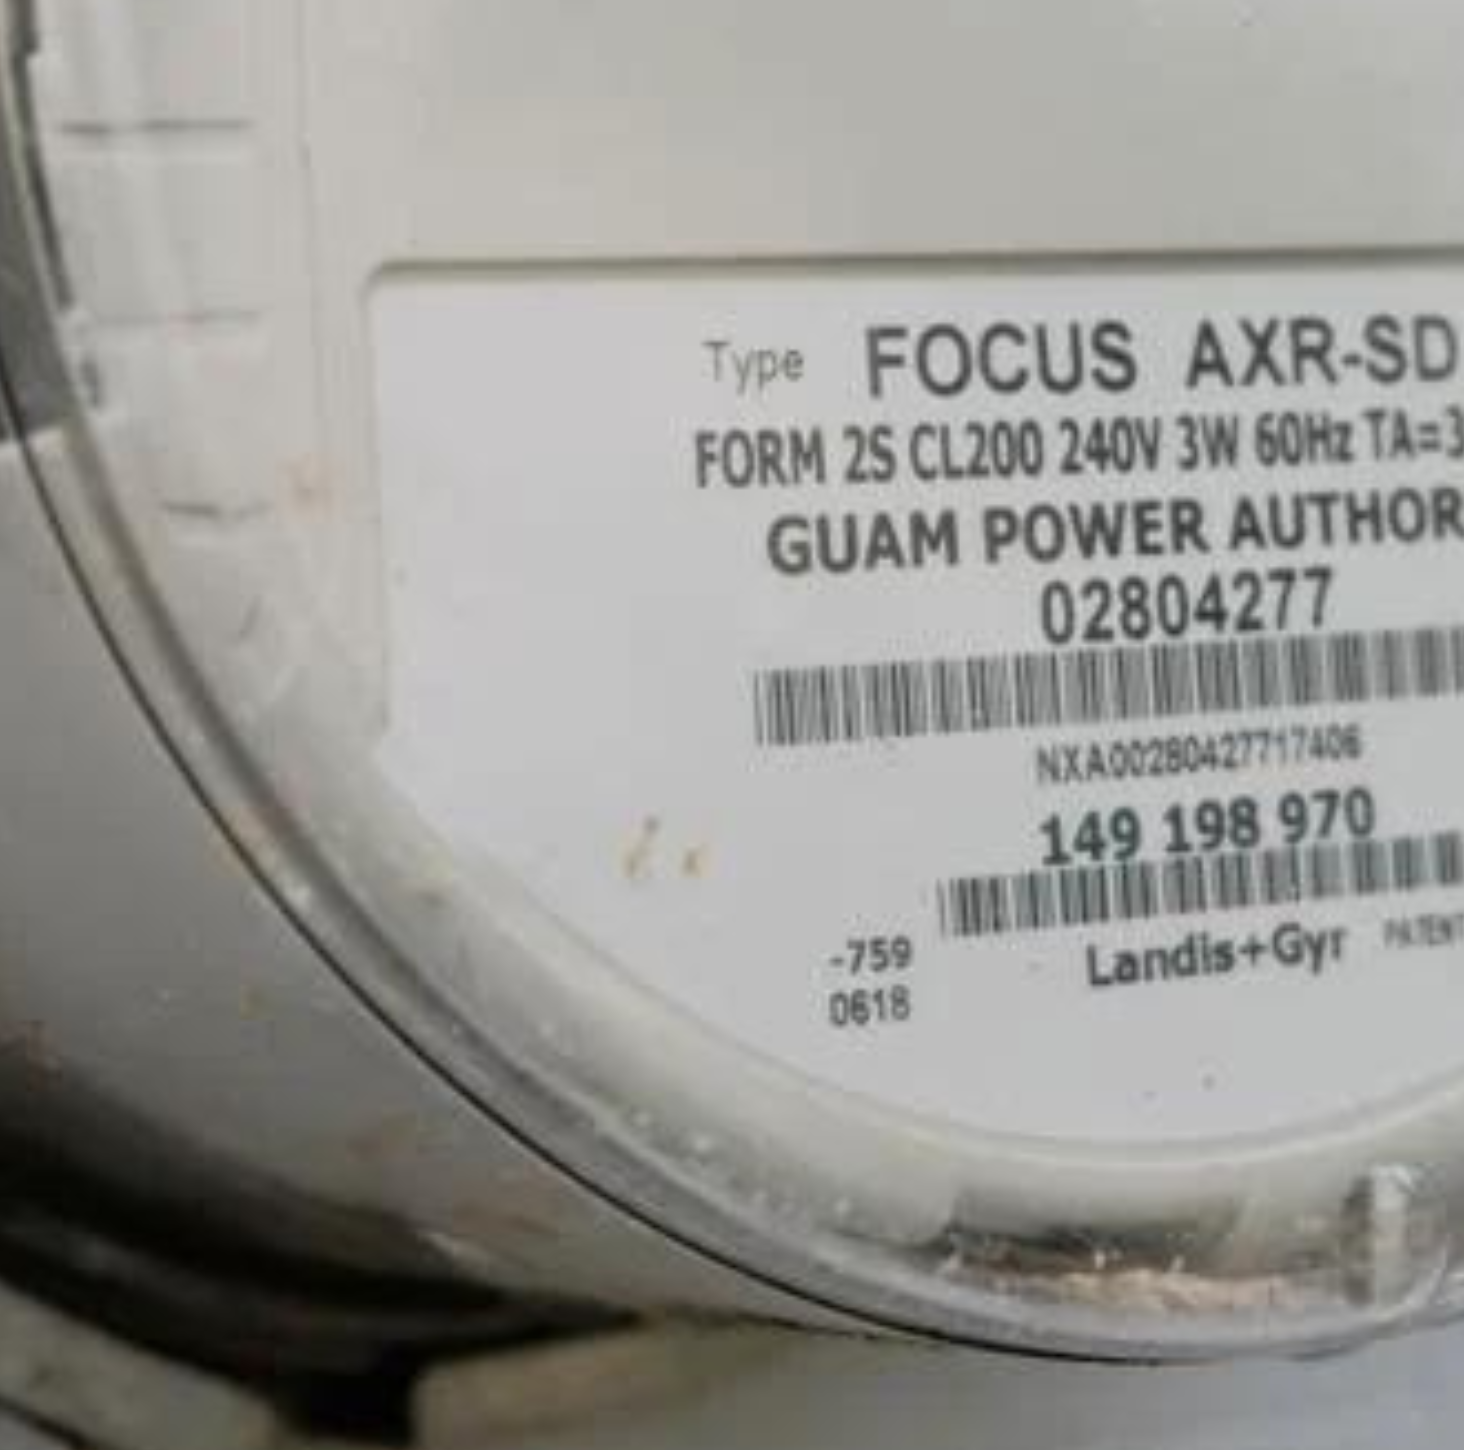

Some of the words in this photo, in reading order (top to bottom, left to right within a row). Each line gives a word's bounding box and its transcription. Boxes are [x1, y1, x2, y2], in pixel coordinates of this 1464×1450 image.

[703, 339, 806, 392] Type
[866, 319, 1139, 398] FOCUS
[1186, 314, 1460, 388] AXR-SD
[695, 426, 828, 489] FORM
[844, 428, 898, 484] 2S
[910, 422, 1044, 480] CL200
[1059, 418, 1162, 476] 240V
[1176, 416, 1242, 470] 3W
[1254, 412, 1353, 466] 60Hz
[768, 512, 960, 576] GUAM
[982, 500, 1210, 564] POWER
[1040, 566, 1336, 644] 02804277
[1038, 808, 1144, 868] 149
[1162, 796, 1262, 854] 198
[1277, 786, 1377, 842] 970
[828, 936, 914, 976] -759
[1087, 924, 1348, 988] Landis+Gyr
[829, 986, 911, 1028] 0618
